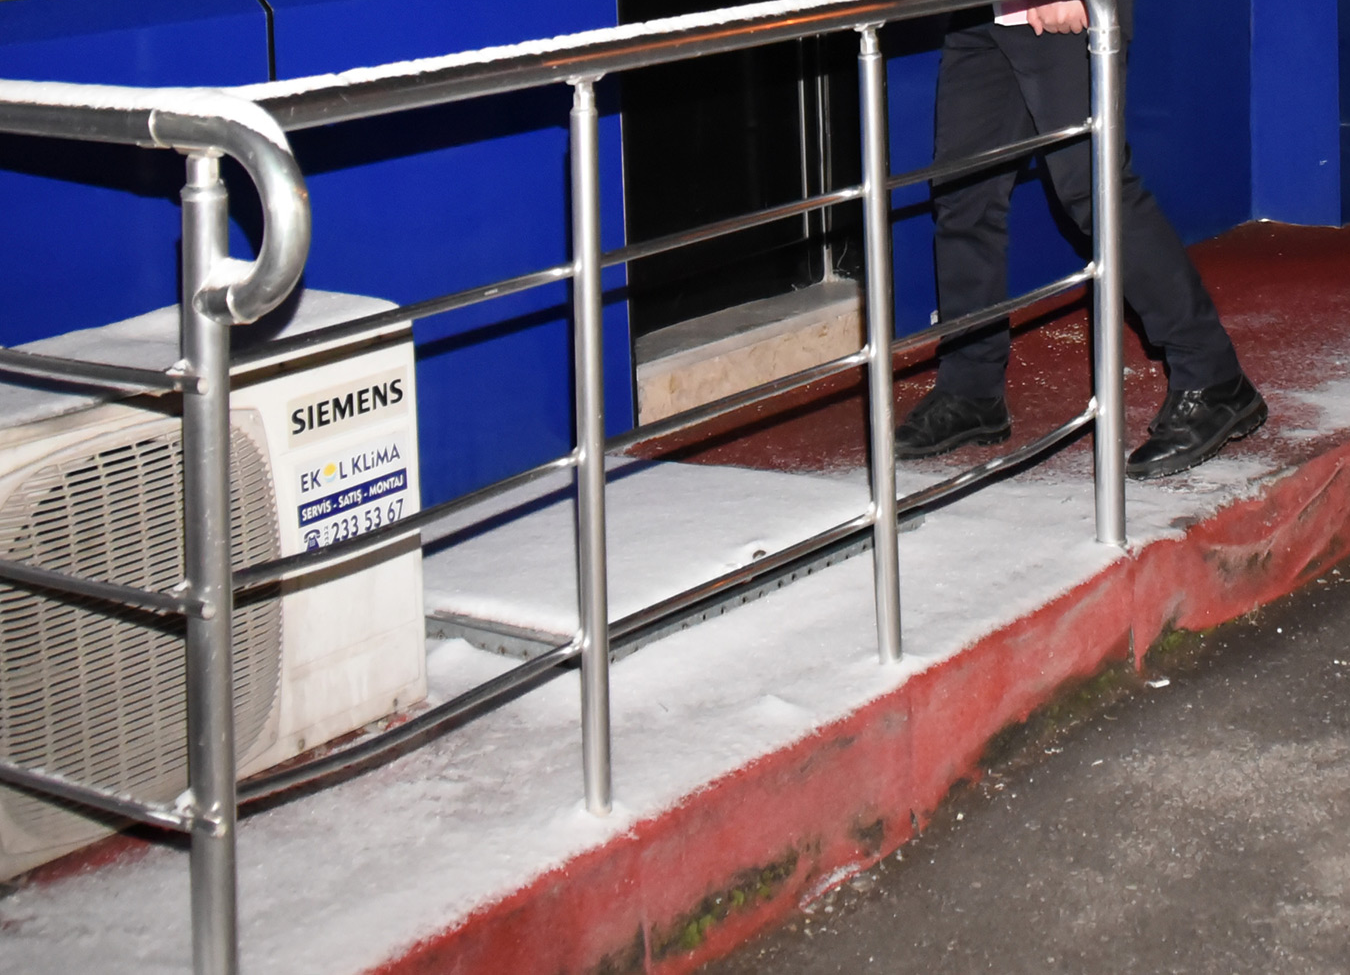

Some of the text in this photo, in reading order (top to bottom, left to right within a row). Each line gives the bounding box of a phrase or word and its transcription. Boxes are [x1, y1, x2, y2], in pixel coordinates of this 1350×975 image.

[291, 378, 403, 435] SIEMENS
[338, 488, 362, 508] SATIŞ
[369, 474, 404, 497] MONTAJ
[331, 514, 359, 543] 233
[364, 506, 382, 532] 53
[387, 498, 404, 523] 67
